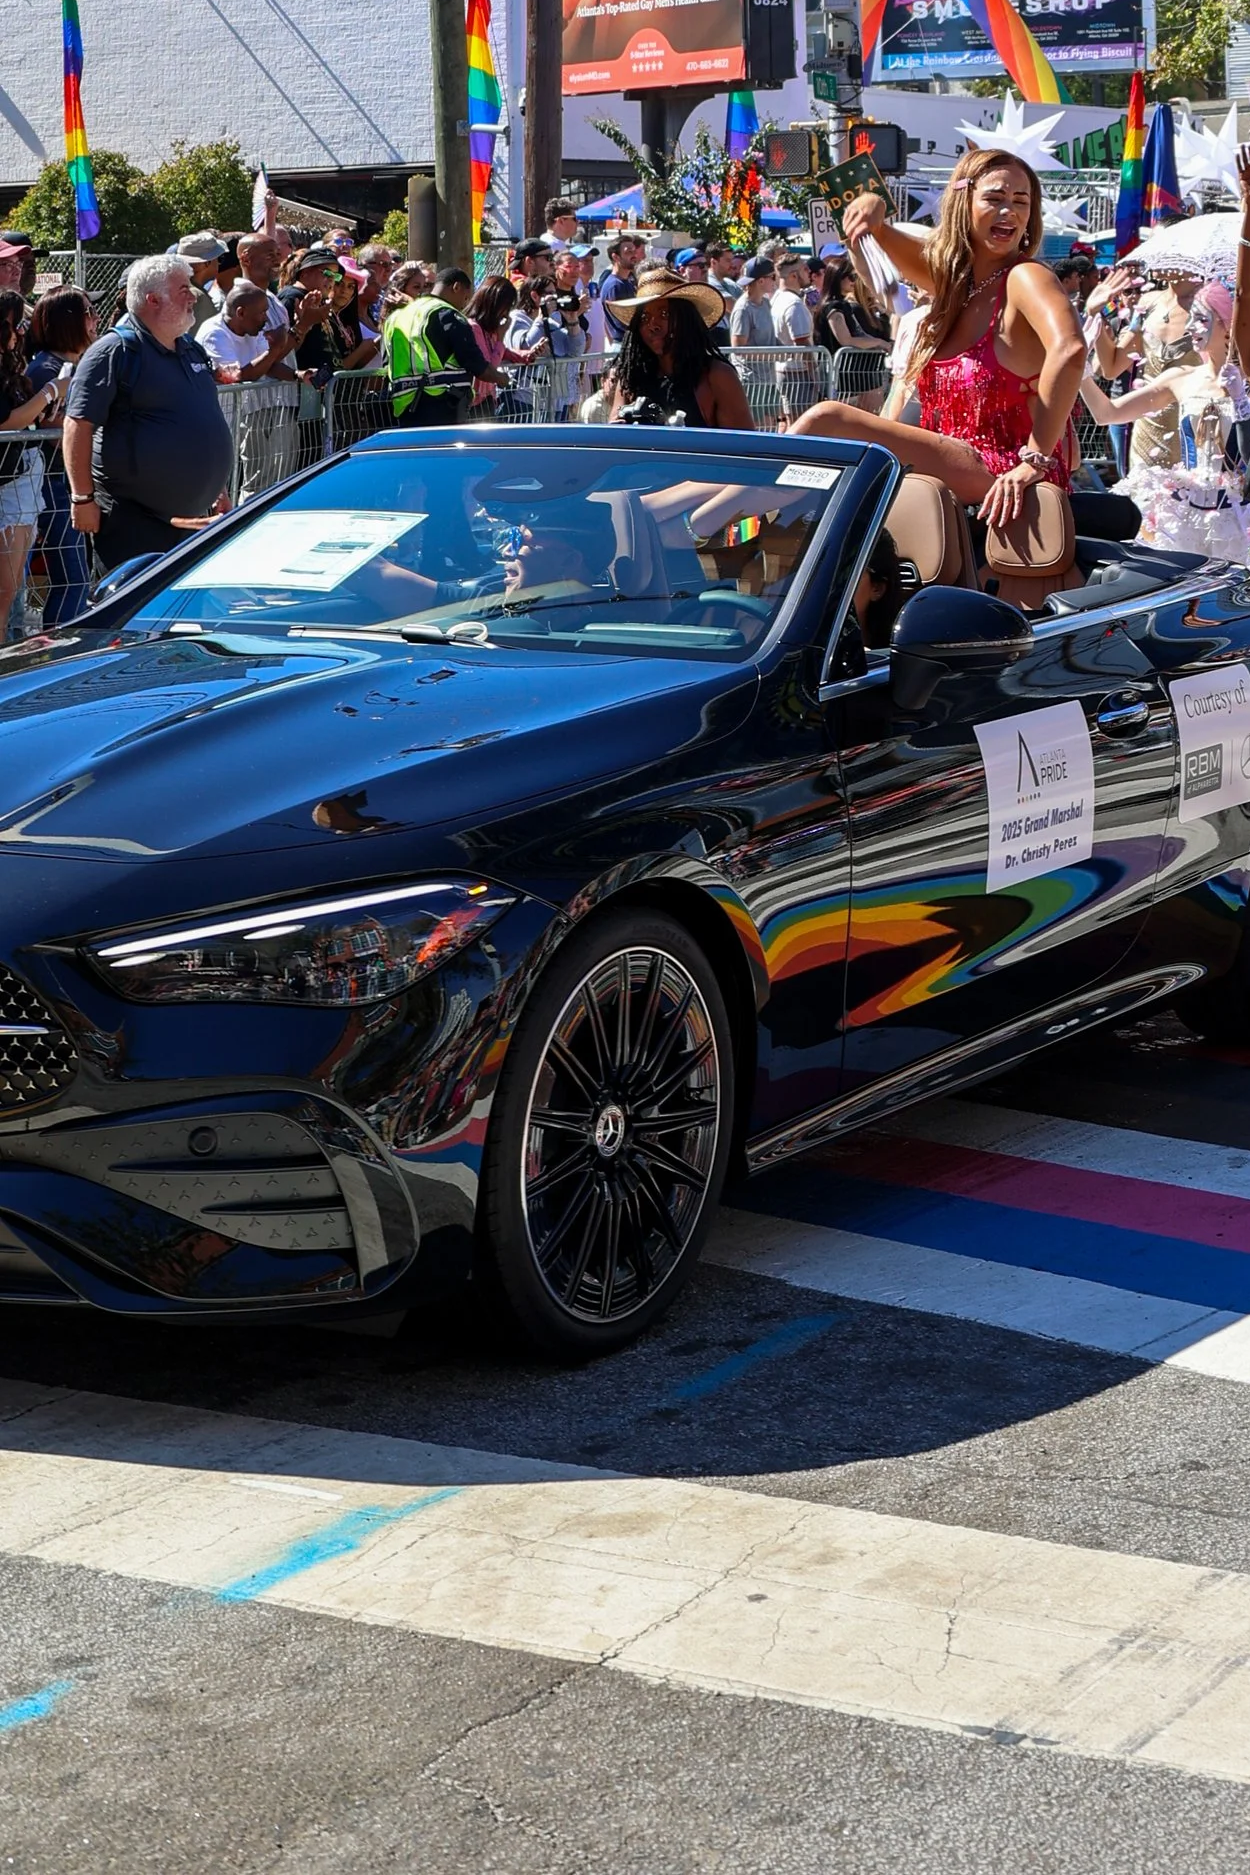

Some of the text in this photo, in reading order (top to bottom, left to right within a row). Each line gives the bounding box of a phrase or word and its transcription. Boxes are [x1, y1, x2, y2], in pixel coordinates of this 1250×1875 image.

[576, 3, 605, 18] Atlanta's
[923, 54, 962, 65] Rainbow
[1071, 48, 1099, 60] Flying
[1101, 47, 1132, 57] Biscuit
[1183, 679, 1247, 719] Courtesy of
[1039, 748, 1066, 766] ATLANTA
[1187, 748, 1221, 779] RBM
[1040, 761, 1068, 786] PRIDE
[1001, 798, 1083, 843] 2025 Grand Marshal
[1005, 835, 1078, 869] Dr. Christy Perez
